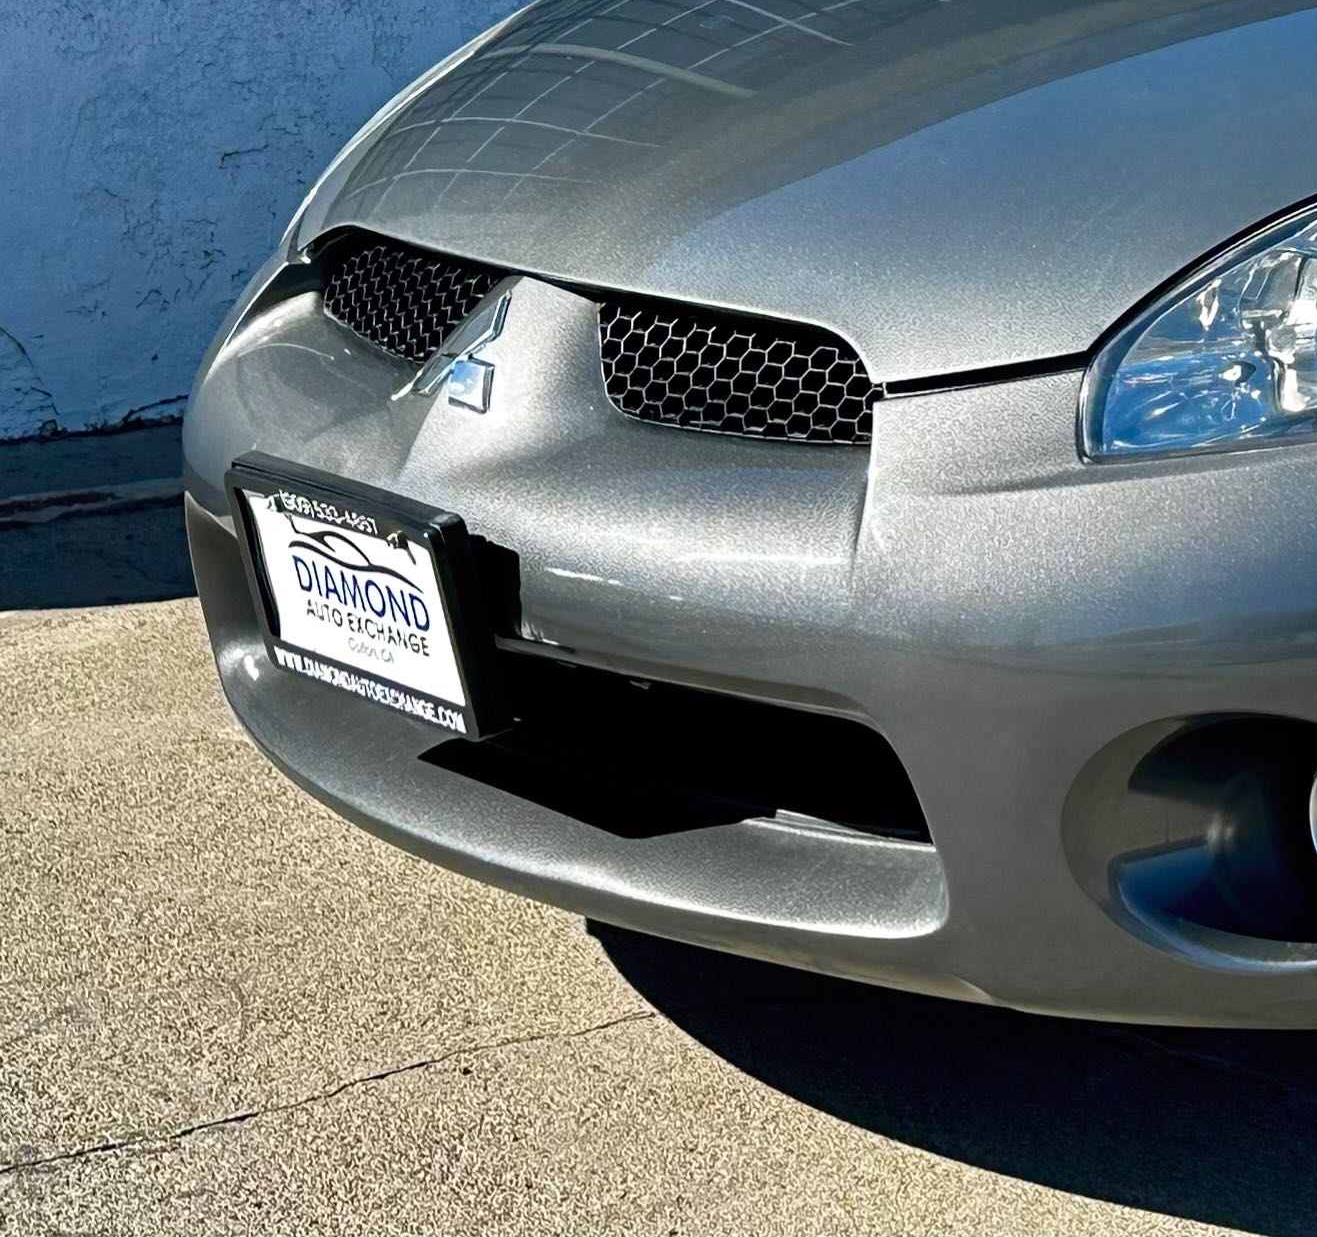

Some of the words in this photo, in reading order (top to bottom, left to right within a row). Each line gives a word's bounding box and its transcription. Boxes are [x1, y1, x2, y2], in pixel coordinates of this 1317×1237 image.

[291, 553, 431, 633] DIAMOND
[306, 598, 344, 628] AUTO
[347, 610, 431, 658] EXCHANGE
